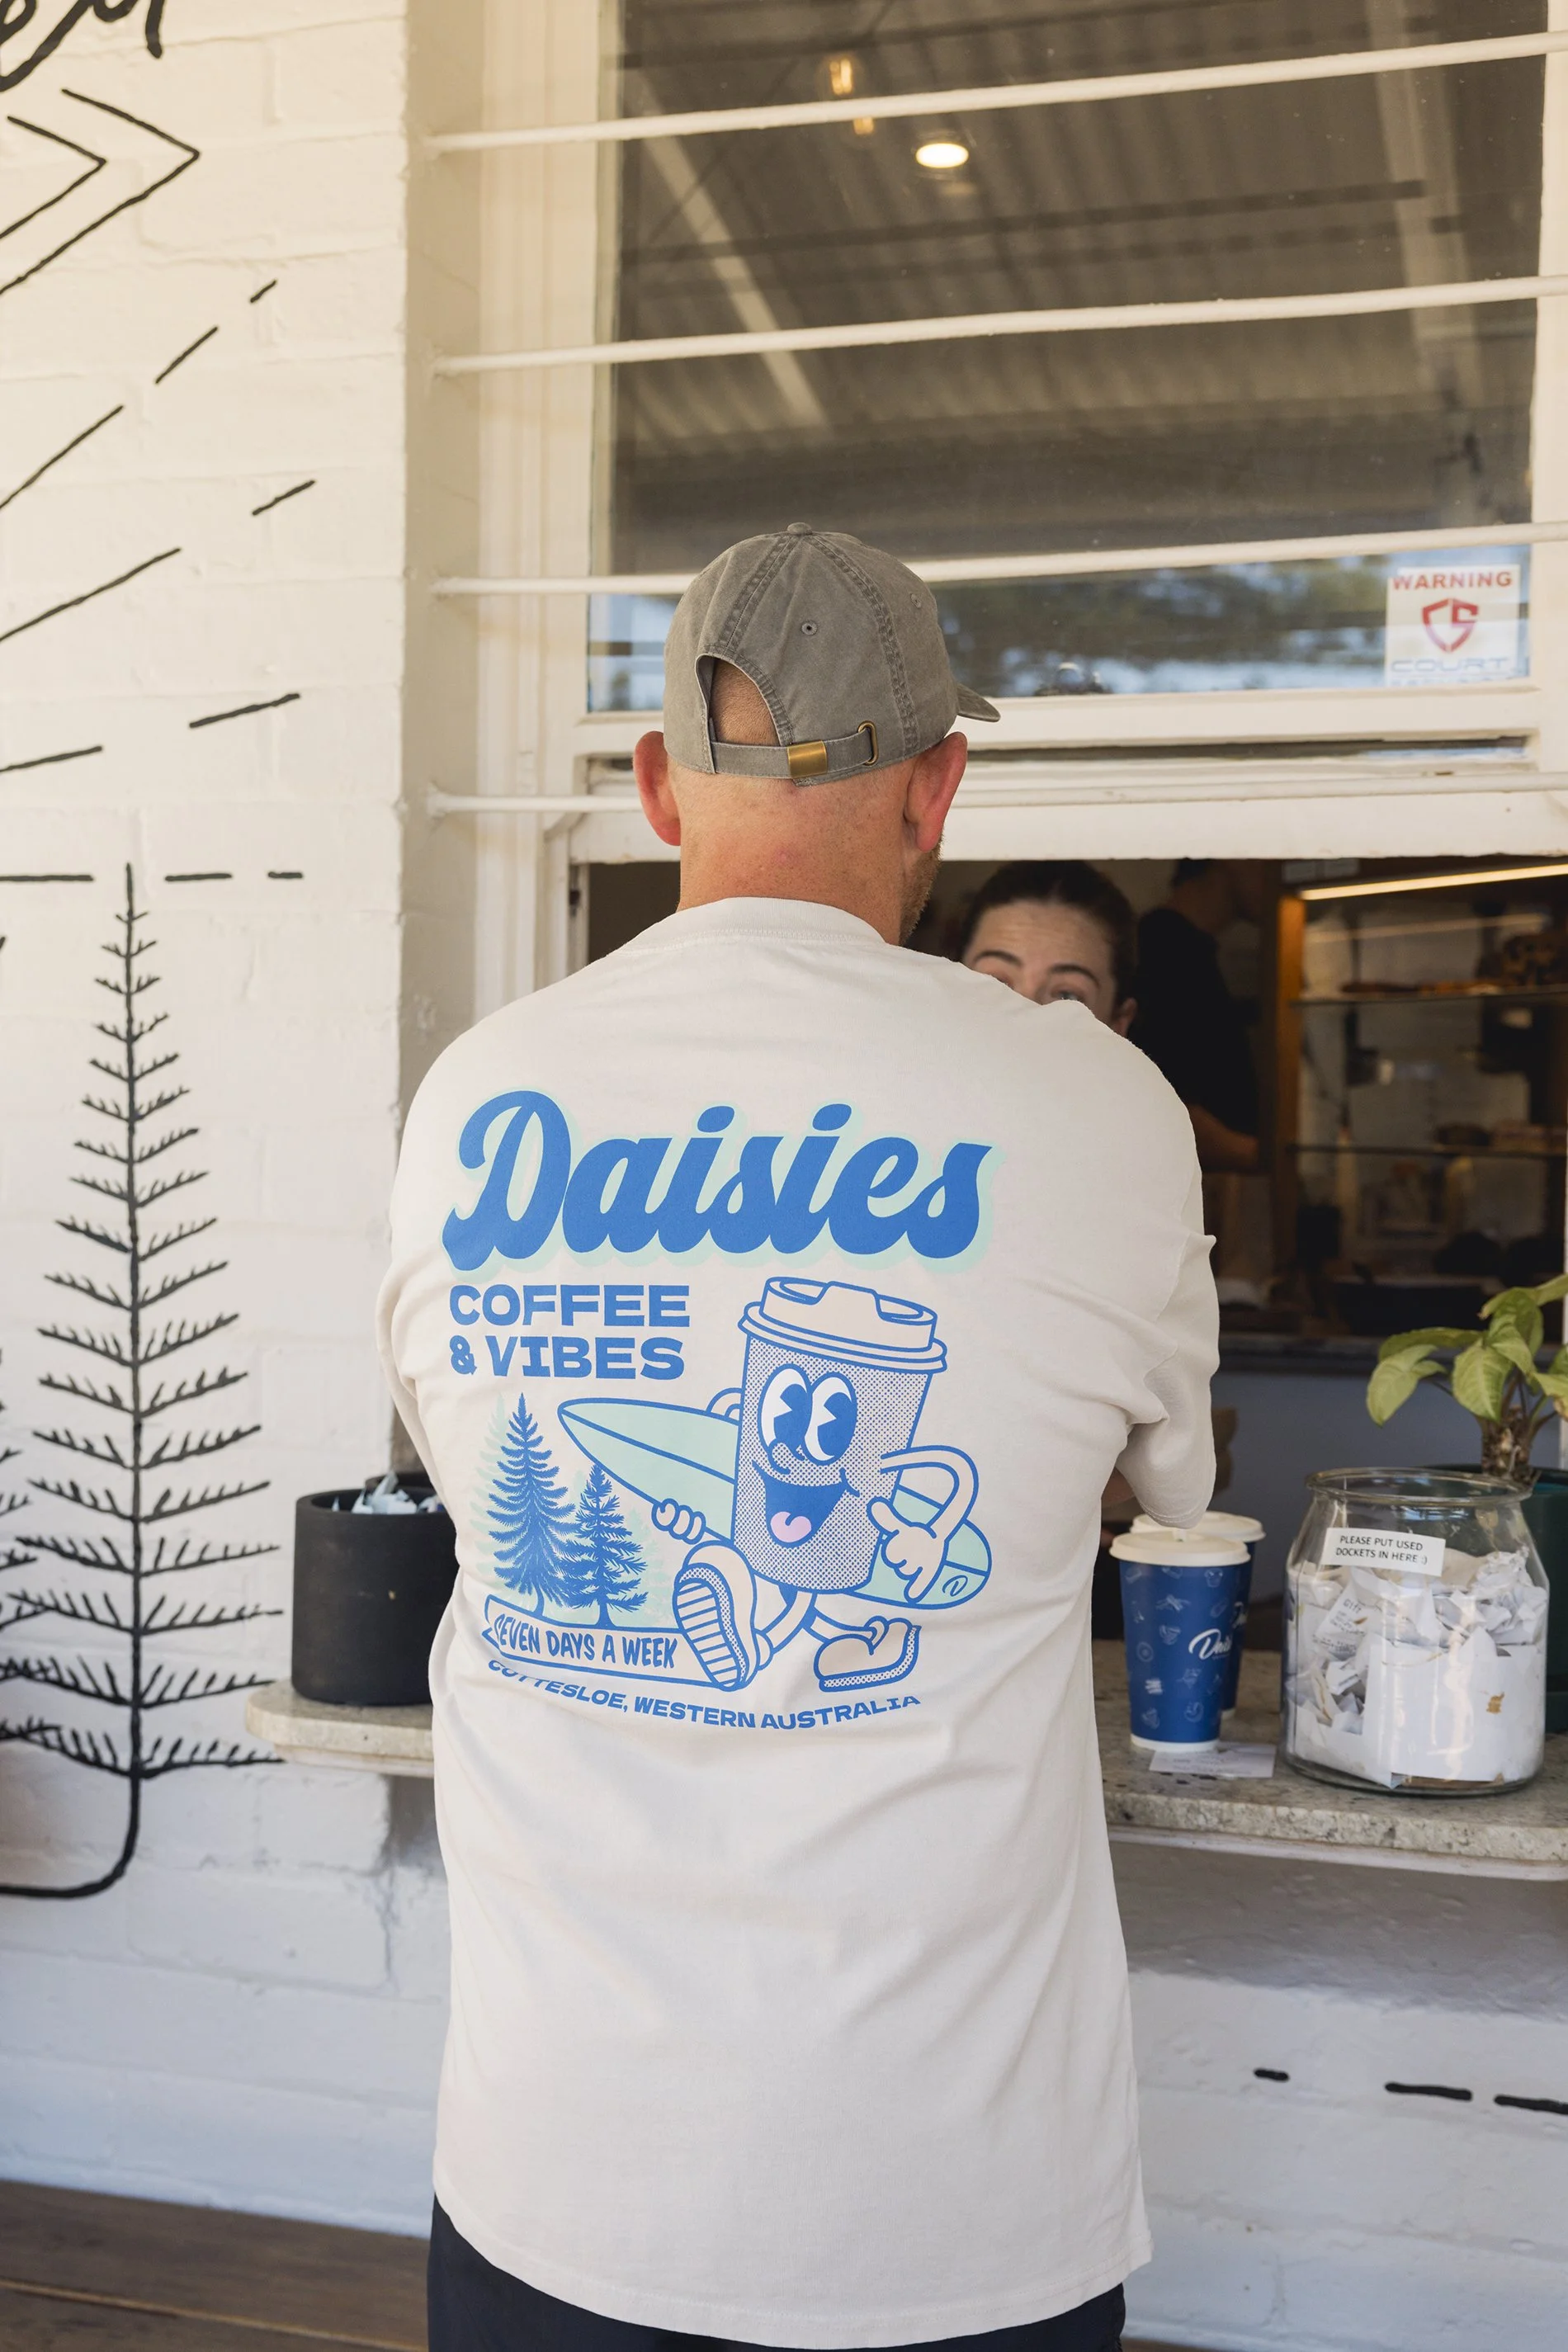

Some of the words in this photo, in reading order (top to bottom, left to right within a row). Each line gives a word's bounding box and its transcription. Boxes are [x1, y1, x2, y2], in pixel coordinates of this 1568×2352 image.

[1392, 570, 1513, 590] WARNING
[1391, 657, 1509, 672] COURT
[442, 1090, 992, 1272] Daisies
[449, 1284, 690, 1327] COFFEE
[449, 1334, 477, 1376] &
[484, 1335, 685, 1380] VIBES
[1335, 1547, 1376, 1558] DOCKETS
[1378, 1551, 1388, 1559] IN
[1391, 1552, 1418, 1563] HERE
[1339, 1535, 1372, 1546] PLEASE
[1374, 1538, 1394, 1547] PUT
[1396, 1541, 1423, 1551] USED
[494, 1613, 541, 1654] SEVEN
[545, 1630, 595, 1660] DAYS
[602, 1635, 616, 1664] A
[622, 1636, 678, 1669] WEEK
[634, 1696, 755, 1729] WESTERN
[761, 1696, 921, 1730] AUSTRALIA
